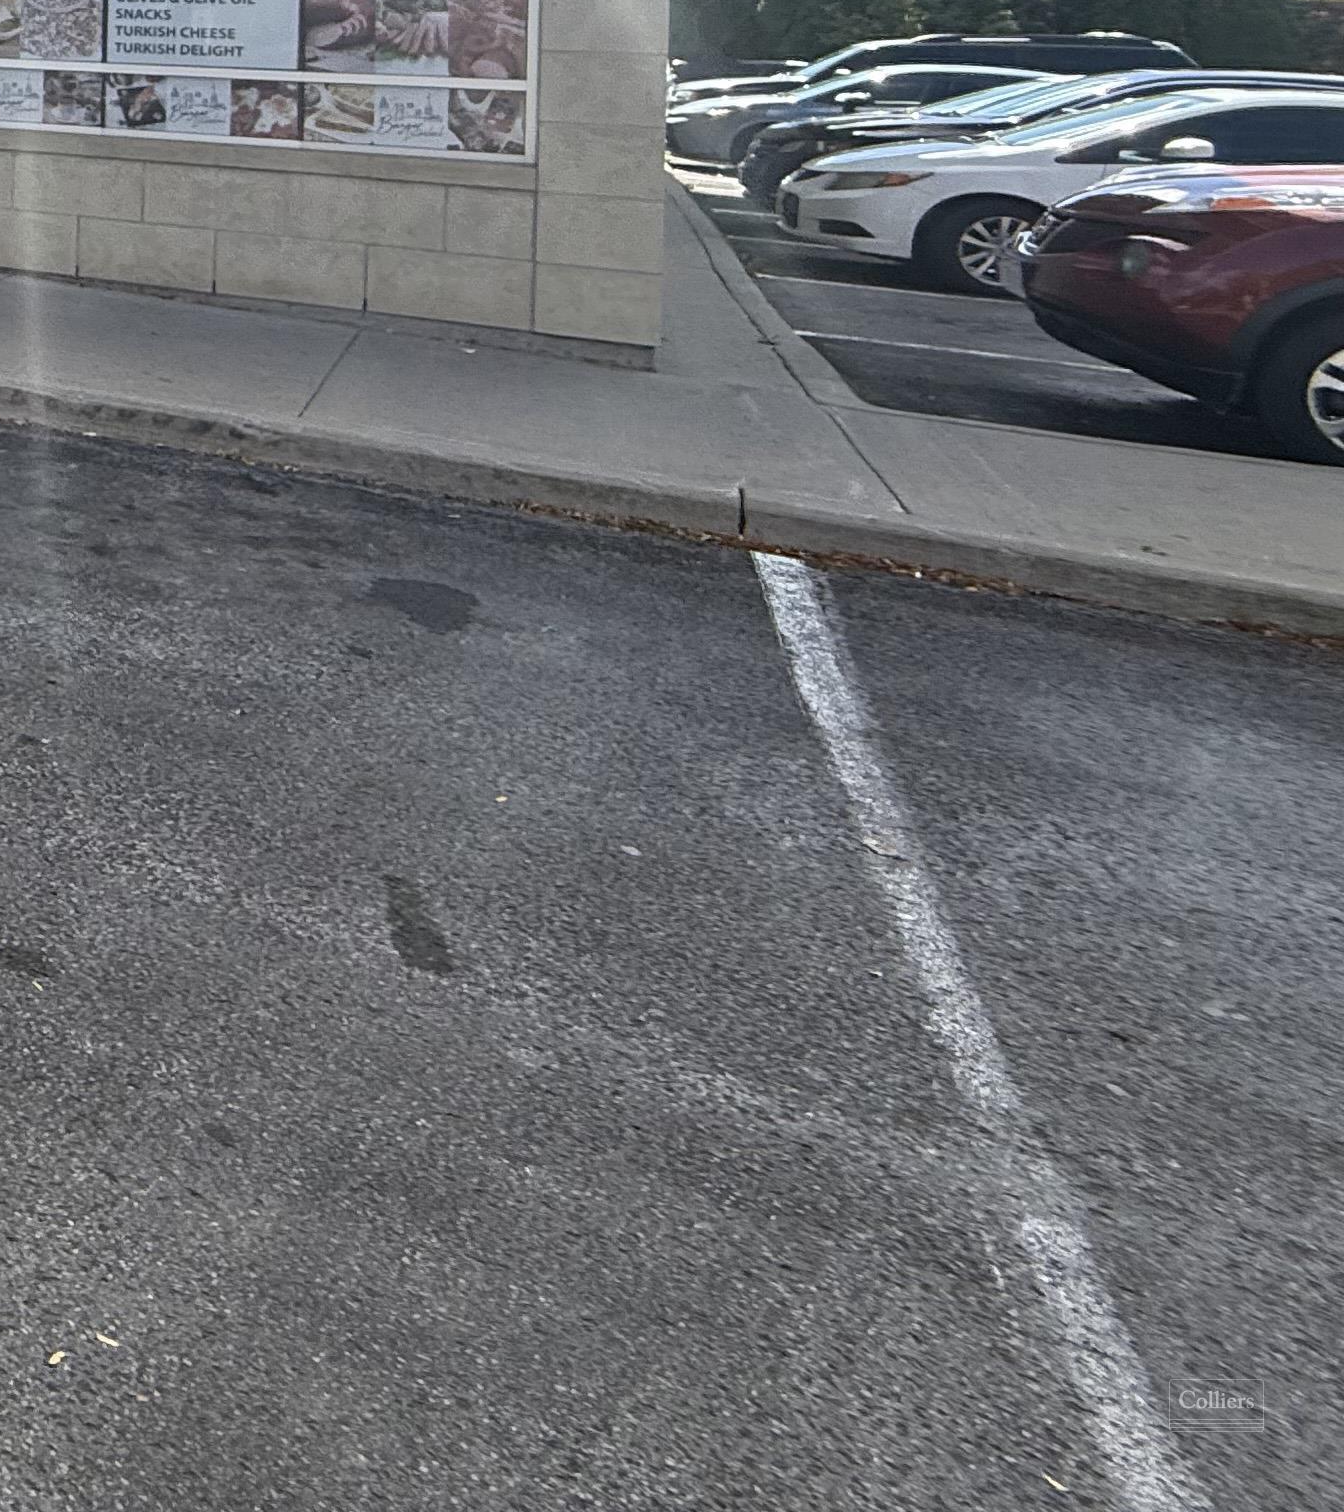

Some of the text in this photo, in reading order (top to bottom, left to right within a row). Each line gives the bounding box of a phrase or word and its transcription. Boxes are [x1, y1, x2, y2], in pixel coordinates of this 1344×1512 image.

[116, 9, 172, 20] SNACKS
[115, 25, 236, 39] TURKISH CHEESE
[115, 42, 244, 56] TURKISH DELIGHT
